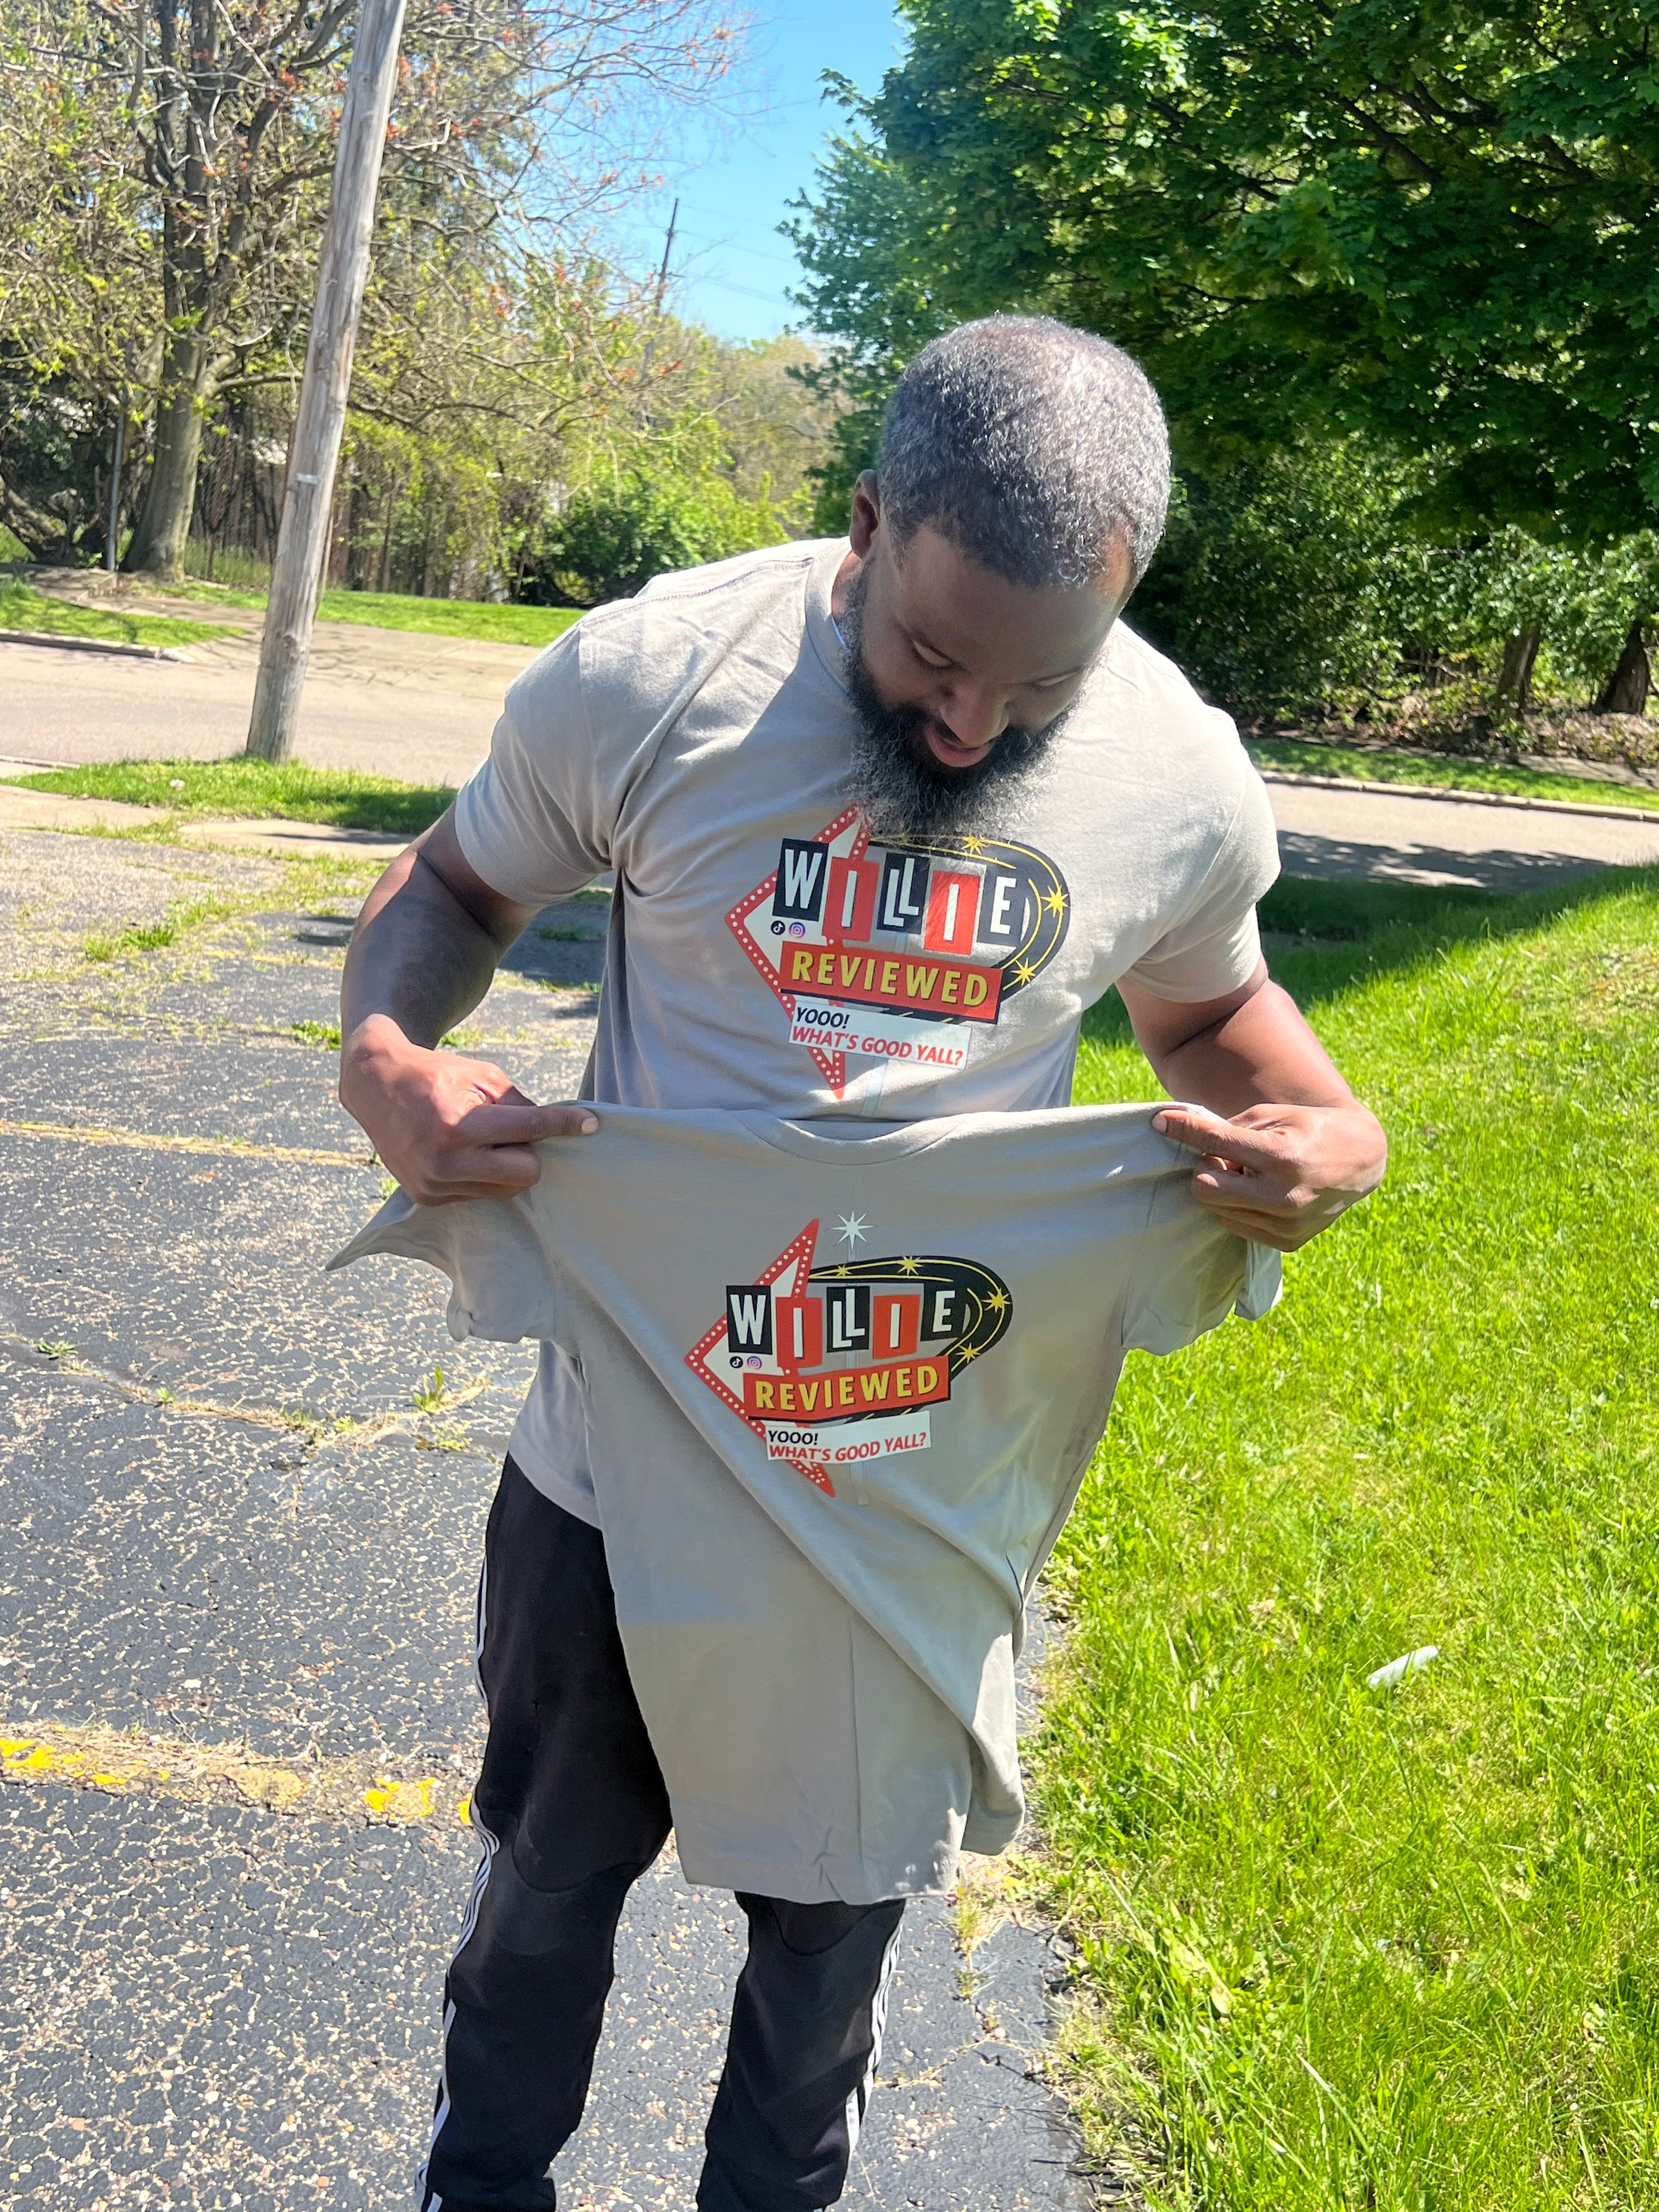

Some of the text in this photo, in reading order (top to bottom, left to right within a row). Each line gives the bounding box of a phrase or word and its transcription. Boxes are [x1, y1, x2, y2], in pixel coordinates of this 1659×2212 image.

[785, 849, 1016, 941] WILLIE
[792, 951, 989, 1007] REVIEWED
[796, 1007, 850, 1029] YOOO!
[792, 1025, 963, 1065] WHAT'S GOOD YALL?
[730, 1289, 955, 1358] WILLIE
[755, 1365, 939, 1412] REVIEWED
[768, 1430, 819, 1445] YOOO!
[769, 1432, 927, 1462] WHAT'S GOOD YALL?
